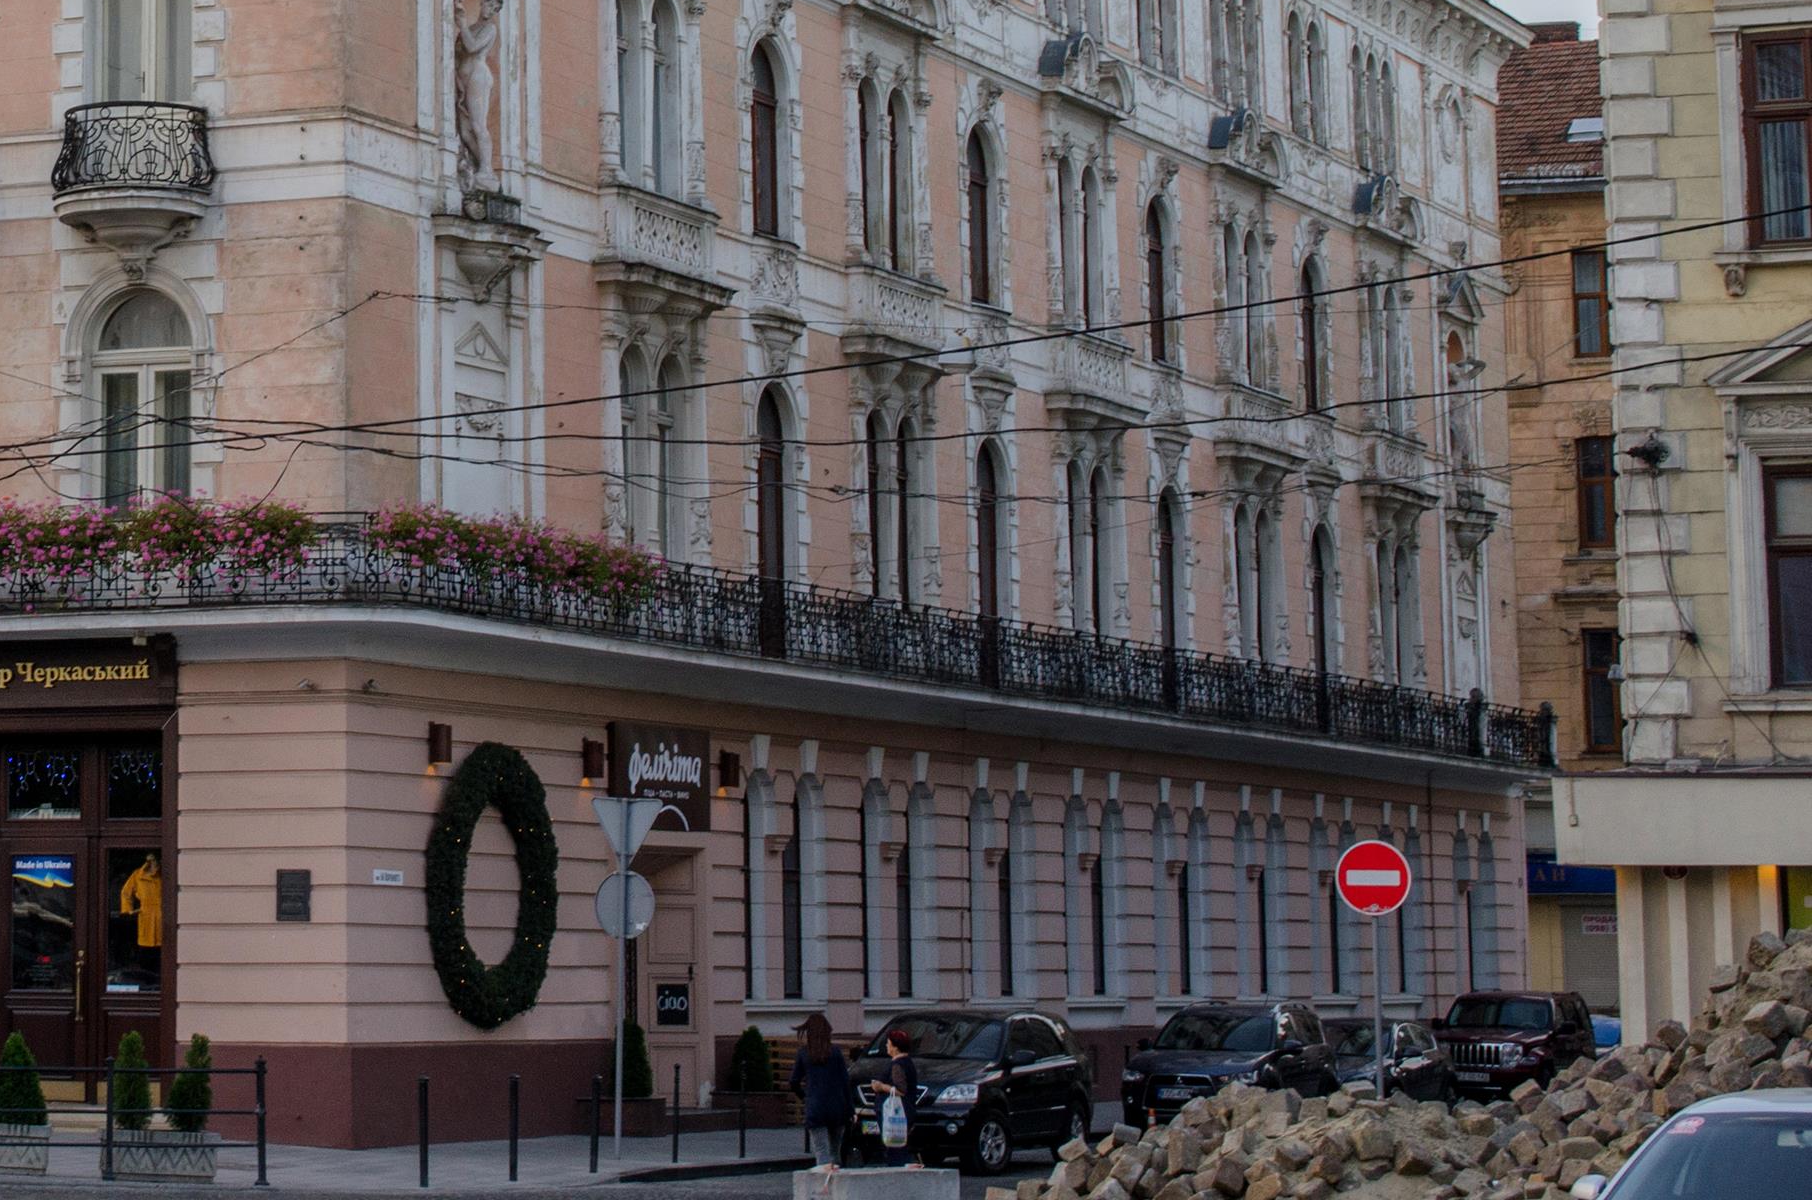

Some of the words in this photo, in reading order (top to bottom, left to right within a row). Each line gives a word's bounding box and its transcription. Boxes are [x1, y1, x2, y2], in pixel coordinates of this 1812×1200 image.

[16, 658, 150, 689] Черкаський
[15, 860, 35, 870] Made
[43, 860, 72, 870] Ukraine
